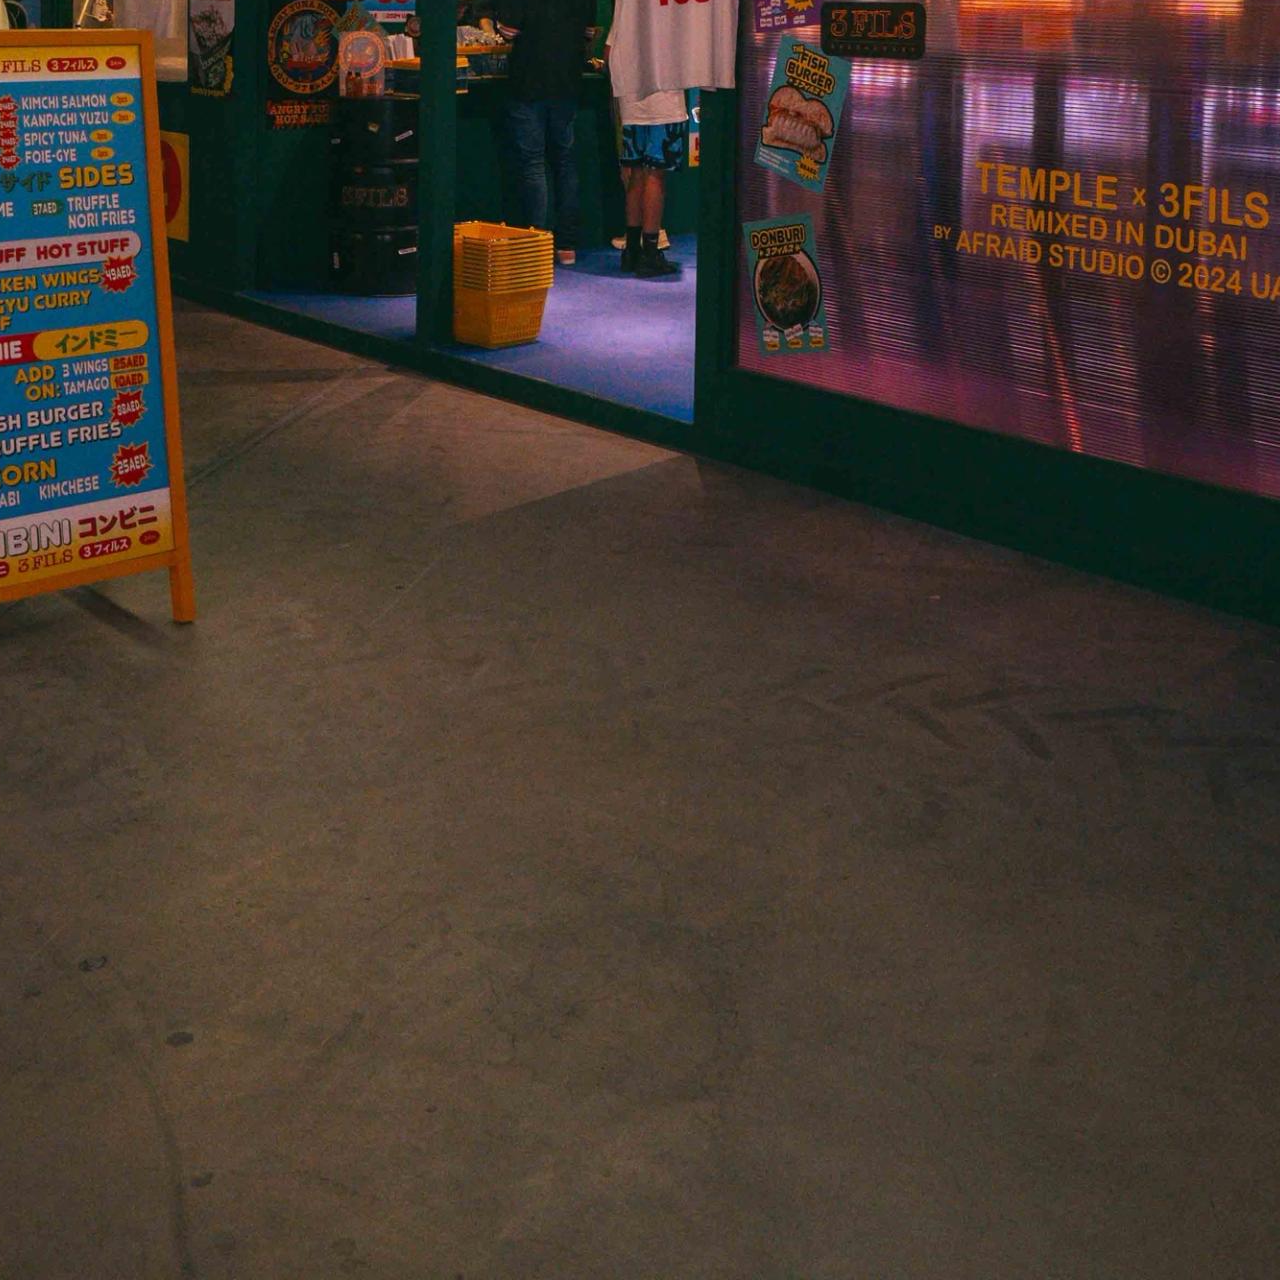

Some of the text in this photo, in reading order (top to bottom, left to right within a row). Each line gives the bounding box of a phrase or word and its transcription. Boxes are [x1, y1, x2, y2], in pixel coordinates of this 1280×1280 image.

[801, 52, 827, 71] FISH
[787, 61, 833, 91] BURGER
[21, 95, 59, 110] KIMCHI
[62, 93, 107, 108] SALMON
[23, 113, 77, 127] KANPACHI
[80, 111, 109, 125] YUZU
[24, 131, 56, 147] SPICY
[58, 130, 88, 144] TUNA
[24, 148, 77, 164] FOIE-GYE
[0, 173, 51, 192] サイド
[59, 164, 134, 190] SIDES
[67, 193, 120, 211] TRUFFLE
[975, 161, 1118, 211] TEMPLE
[1159, 182, 1269, 229] 3FILS
[32, 202, 57, 215] 37AED
[68, 210, 136, 229] NORI FRIES
[751, 226, 804, 248] DONBURI
[991, 204, 1247, 261] REMIXED IN DUBAI
[36, 238, 130, 261] HOT STUFF
[933, 224, 952, 240] BY
[956, 230, 1042, 265] AFRAID
[1049, 244, 1144, 280] STUDIO
[1178, 263, 1242, 296] 2024
[41, 269, 101, 291] WINGS
[106, 265, 131, 280] 49AED
[34, 290, 92, 310] CURRY
[55, 326, 138, 354] インドミー
[62, 358, 109, 378] 3 WINGS
[113, 355, 146, 370] 25AED
[15, 363, 55, 385] ADD
[114, 373, 144, 389] 10AED
[63, 378, 109, 396] TAMAGO
[27, 400, 104, 426] BURGER
[68, 421, 122, 444] FRIES
[117, 457, 147, 475] 25AED
[38, 475, 100, 501] KIMCHESE
[78, 504, 158, 538] コンビニ
